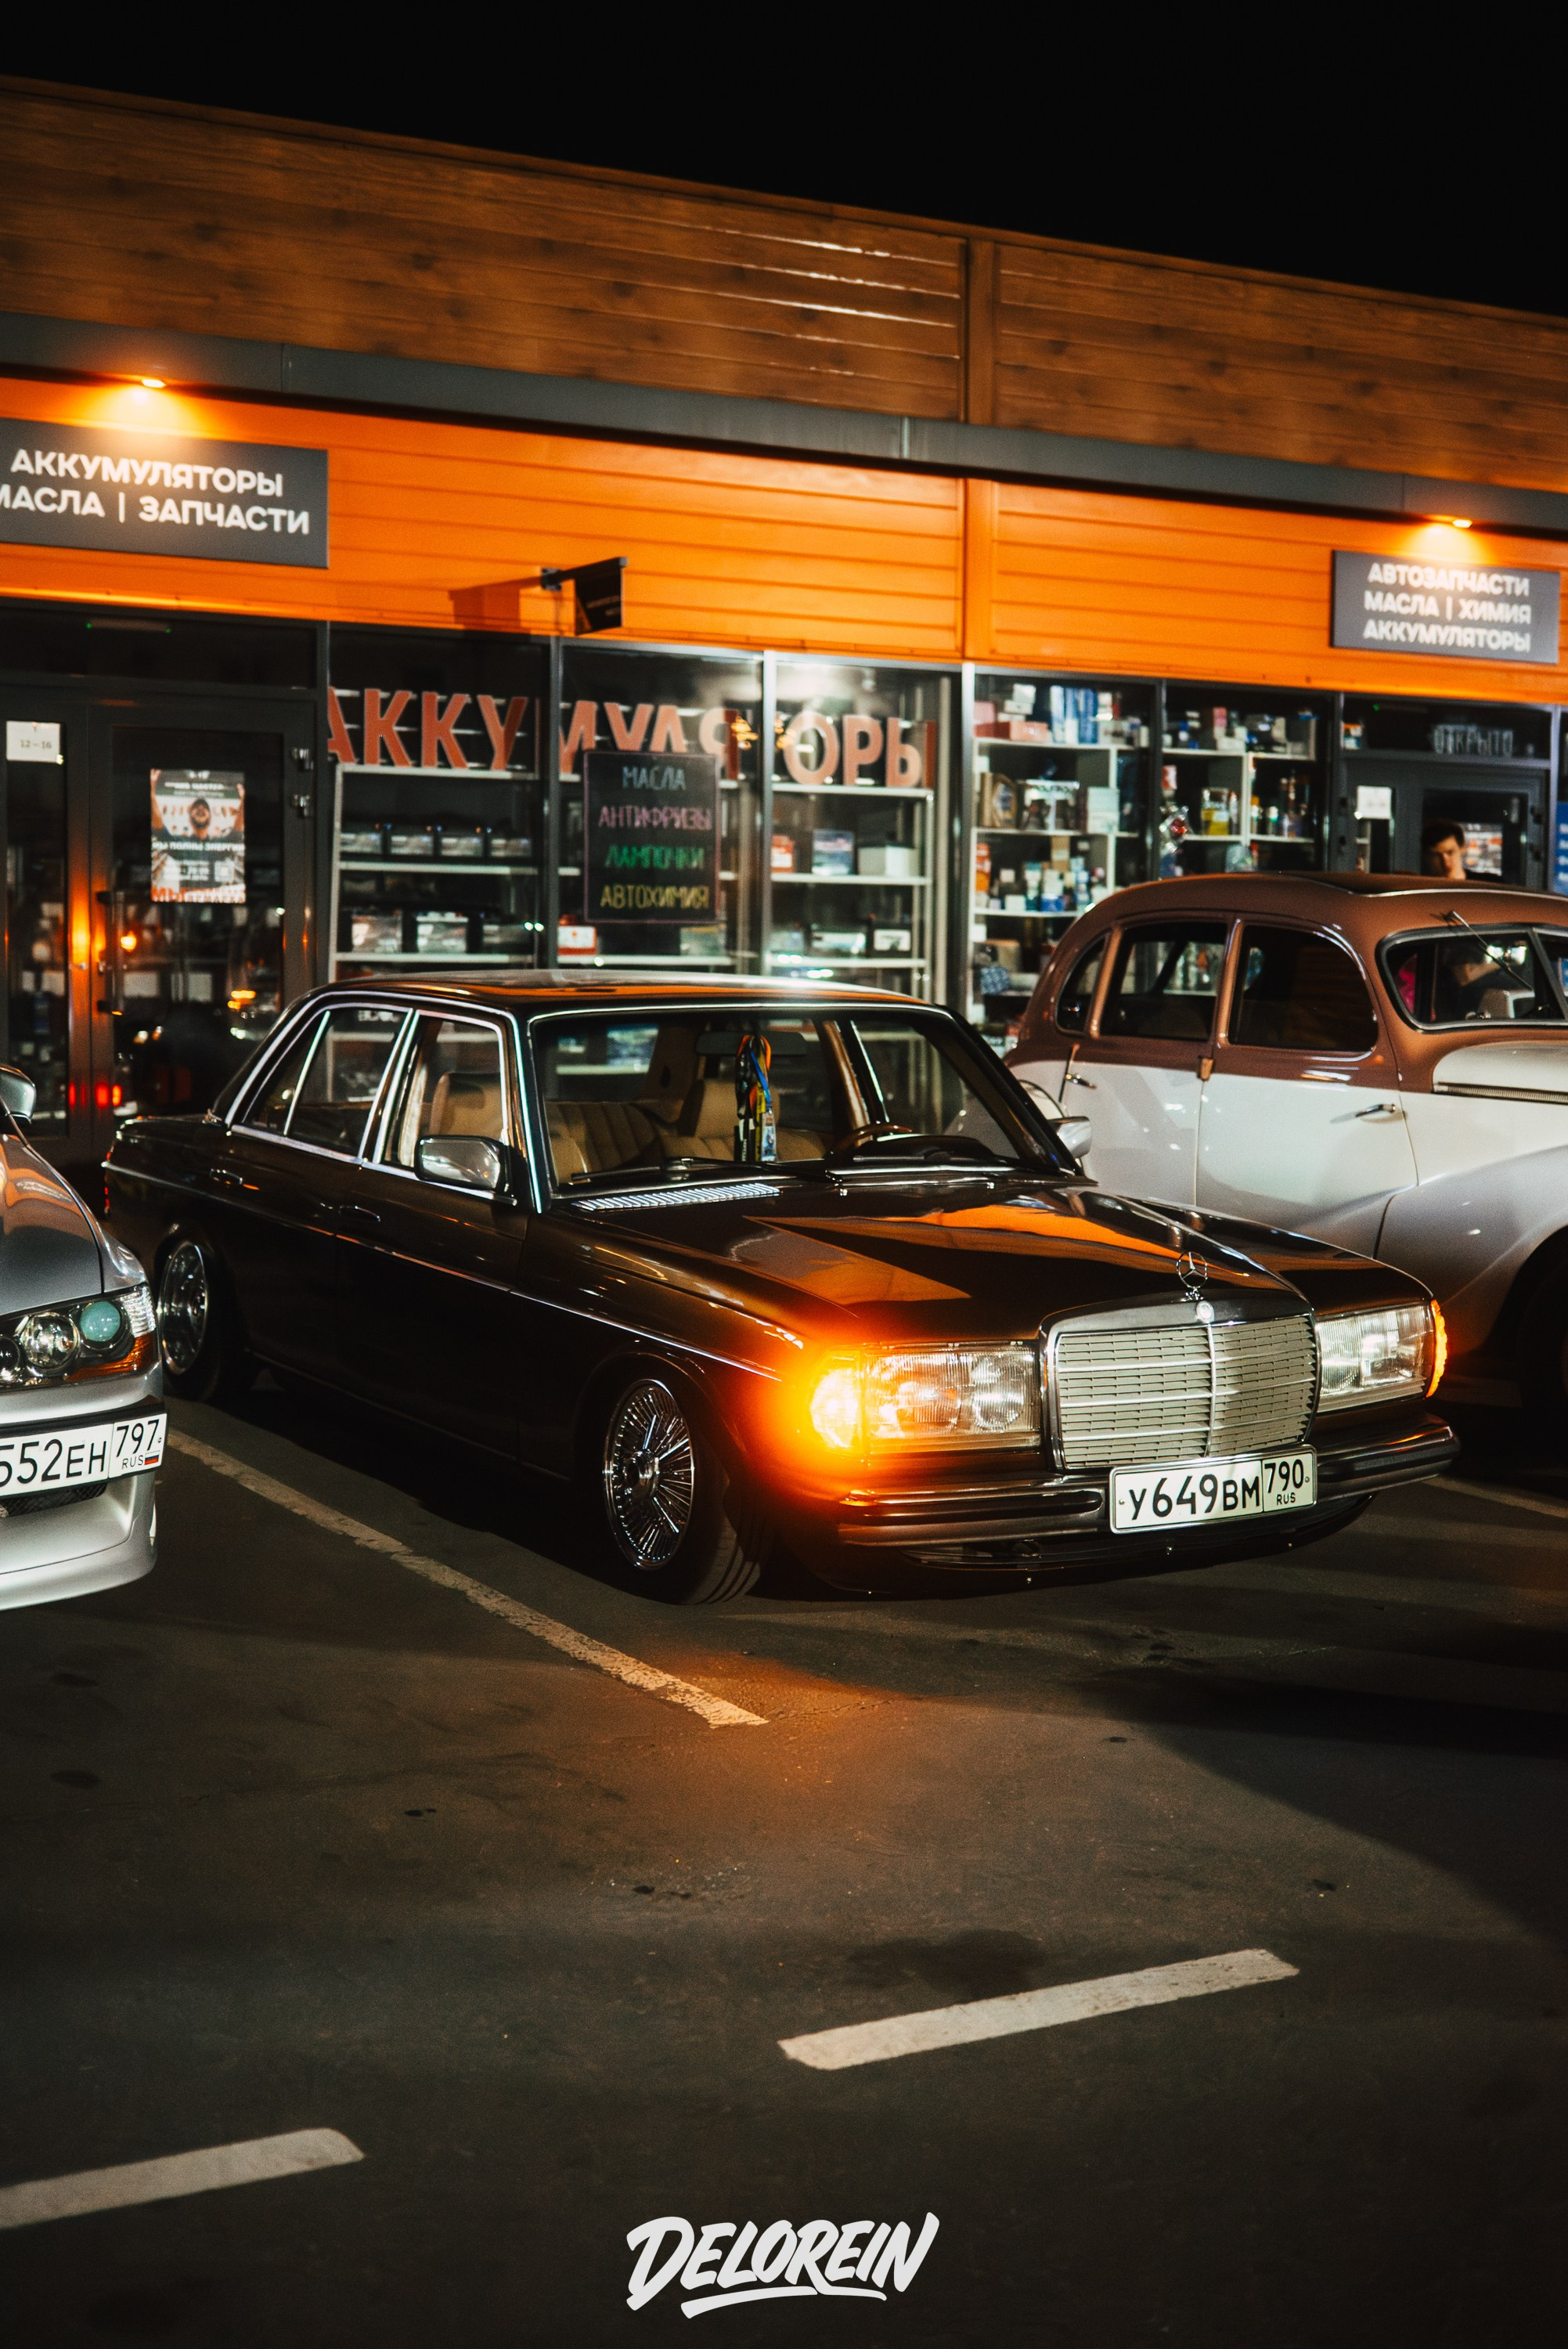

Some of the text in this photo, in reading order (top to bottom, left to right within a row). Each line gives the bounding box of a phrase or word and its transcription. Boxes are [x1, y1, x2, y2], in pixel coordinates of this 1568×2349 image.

[10, 448, 283, 498] АККУМУЛЯТОРЫ
[139, 495, 310, 535] ЗАПЧАСТИ
[1368, 561, 1530, 597] АВТОЗАПЧАСТИ
[1364, 590, 1440, 618] МАСЛА
[1458, 597, 1532, 626] ХИМИЯ
[1363, 619, 1531, 654] АККУМУЛЯТОРЫ
[621, 765, 687, 791] МАСЛА
[600, 883, 710, 910] АВТОХИМИЯ
[116, 1418, 160, 1458] 797
[121, 1454, 144, 1470] RUS
[1264, 1458, 1305, 1494] 790
[1276, 1492, 1296, 1506] RUS
